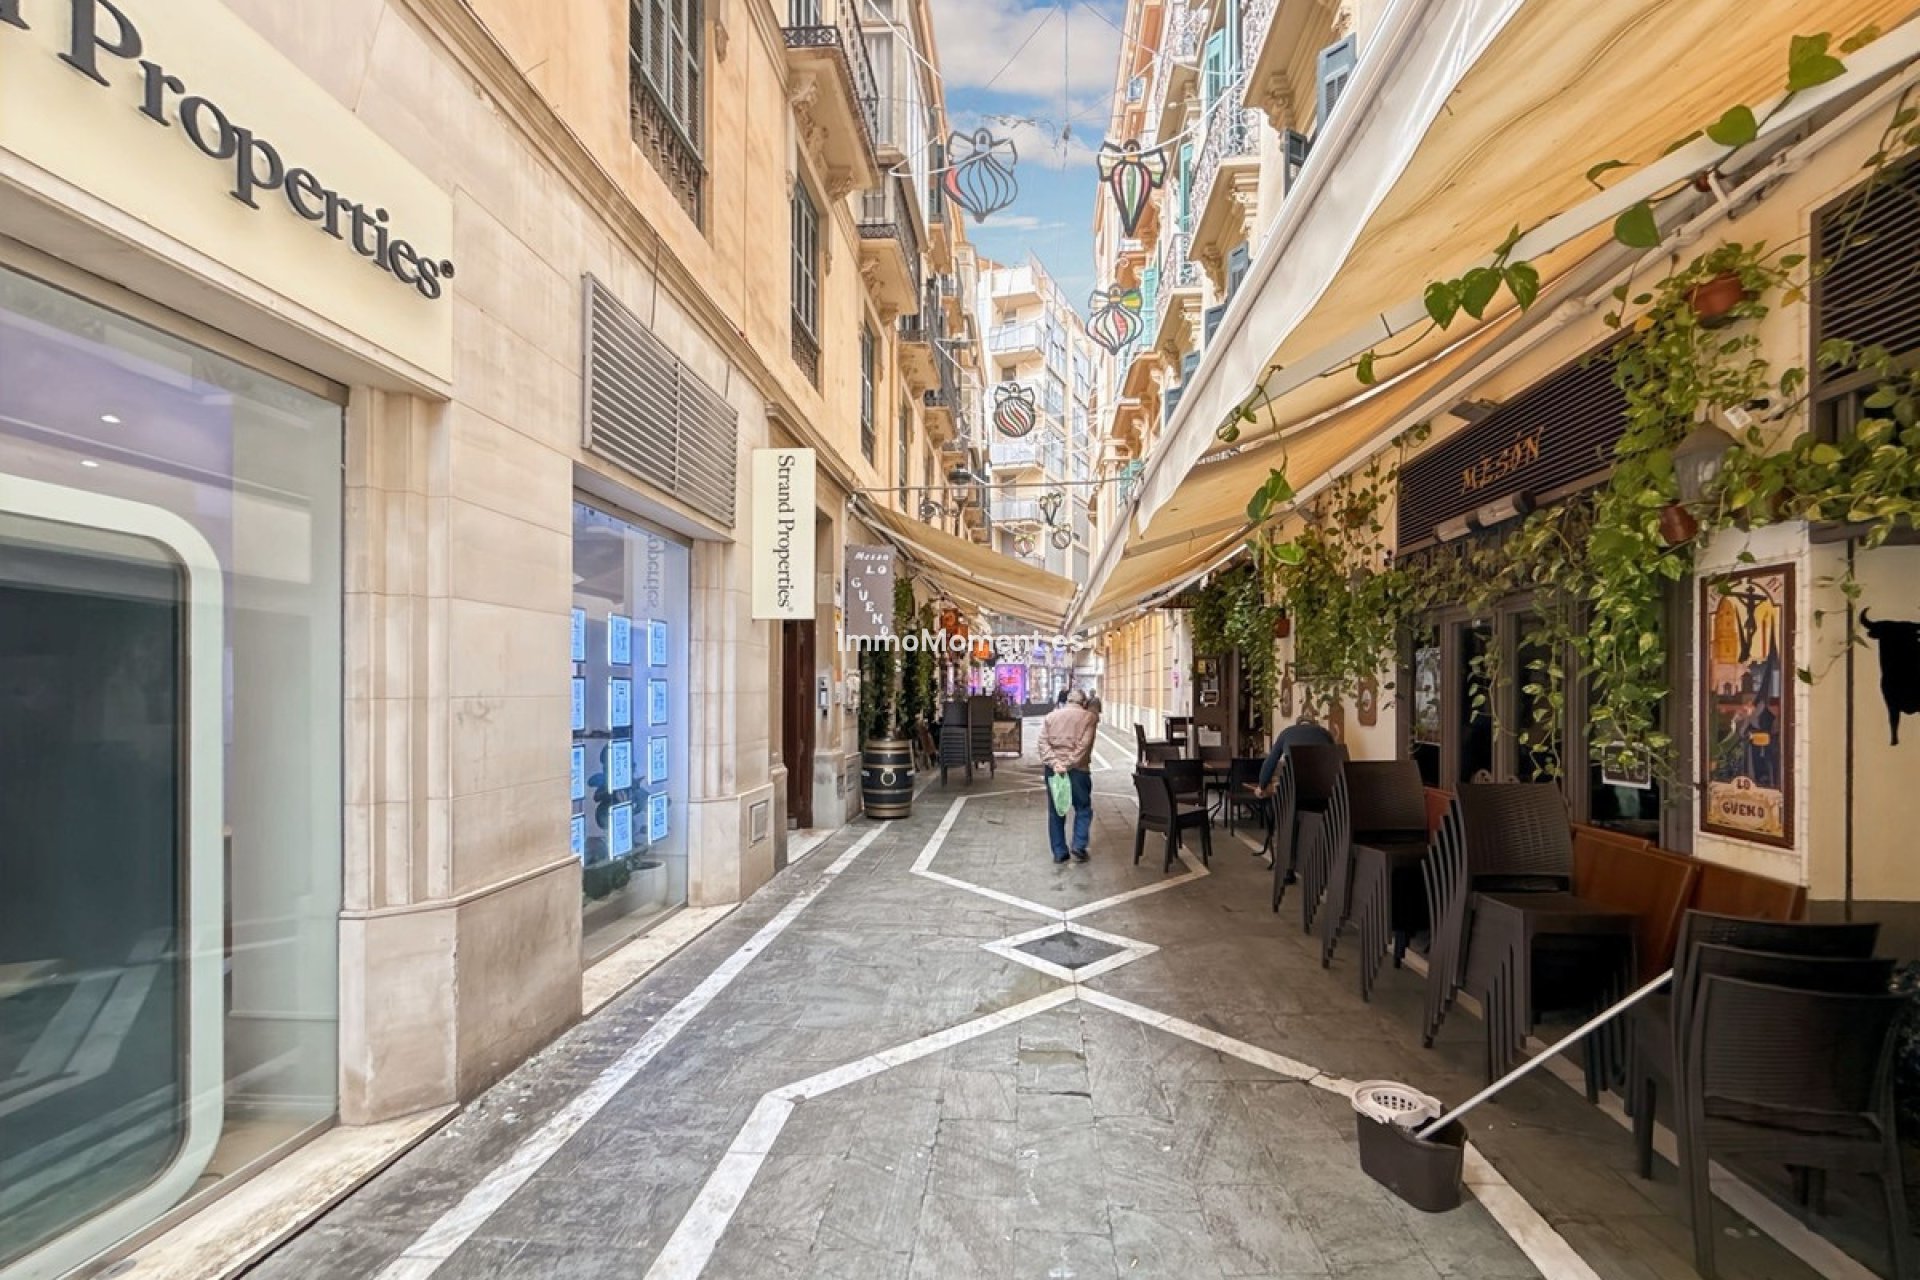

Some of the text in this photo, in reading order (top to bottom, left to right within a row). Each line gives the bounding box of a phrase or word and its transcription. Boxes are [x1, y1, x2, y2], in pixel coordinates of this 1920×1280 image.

[777, 455, 796, 513] Strand
[865, 564, 887, 575] LO
[1736, 778, 1751, 790] LO
